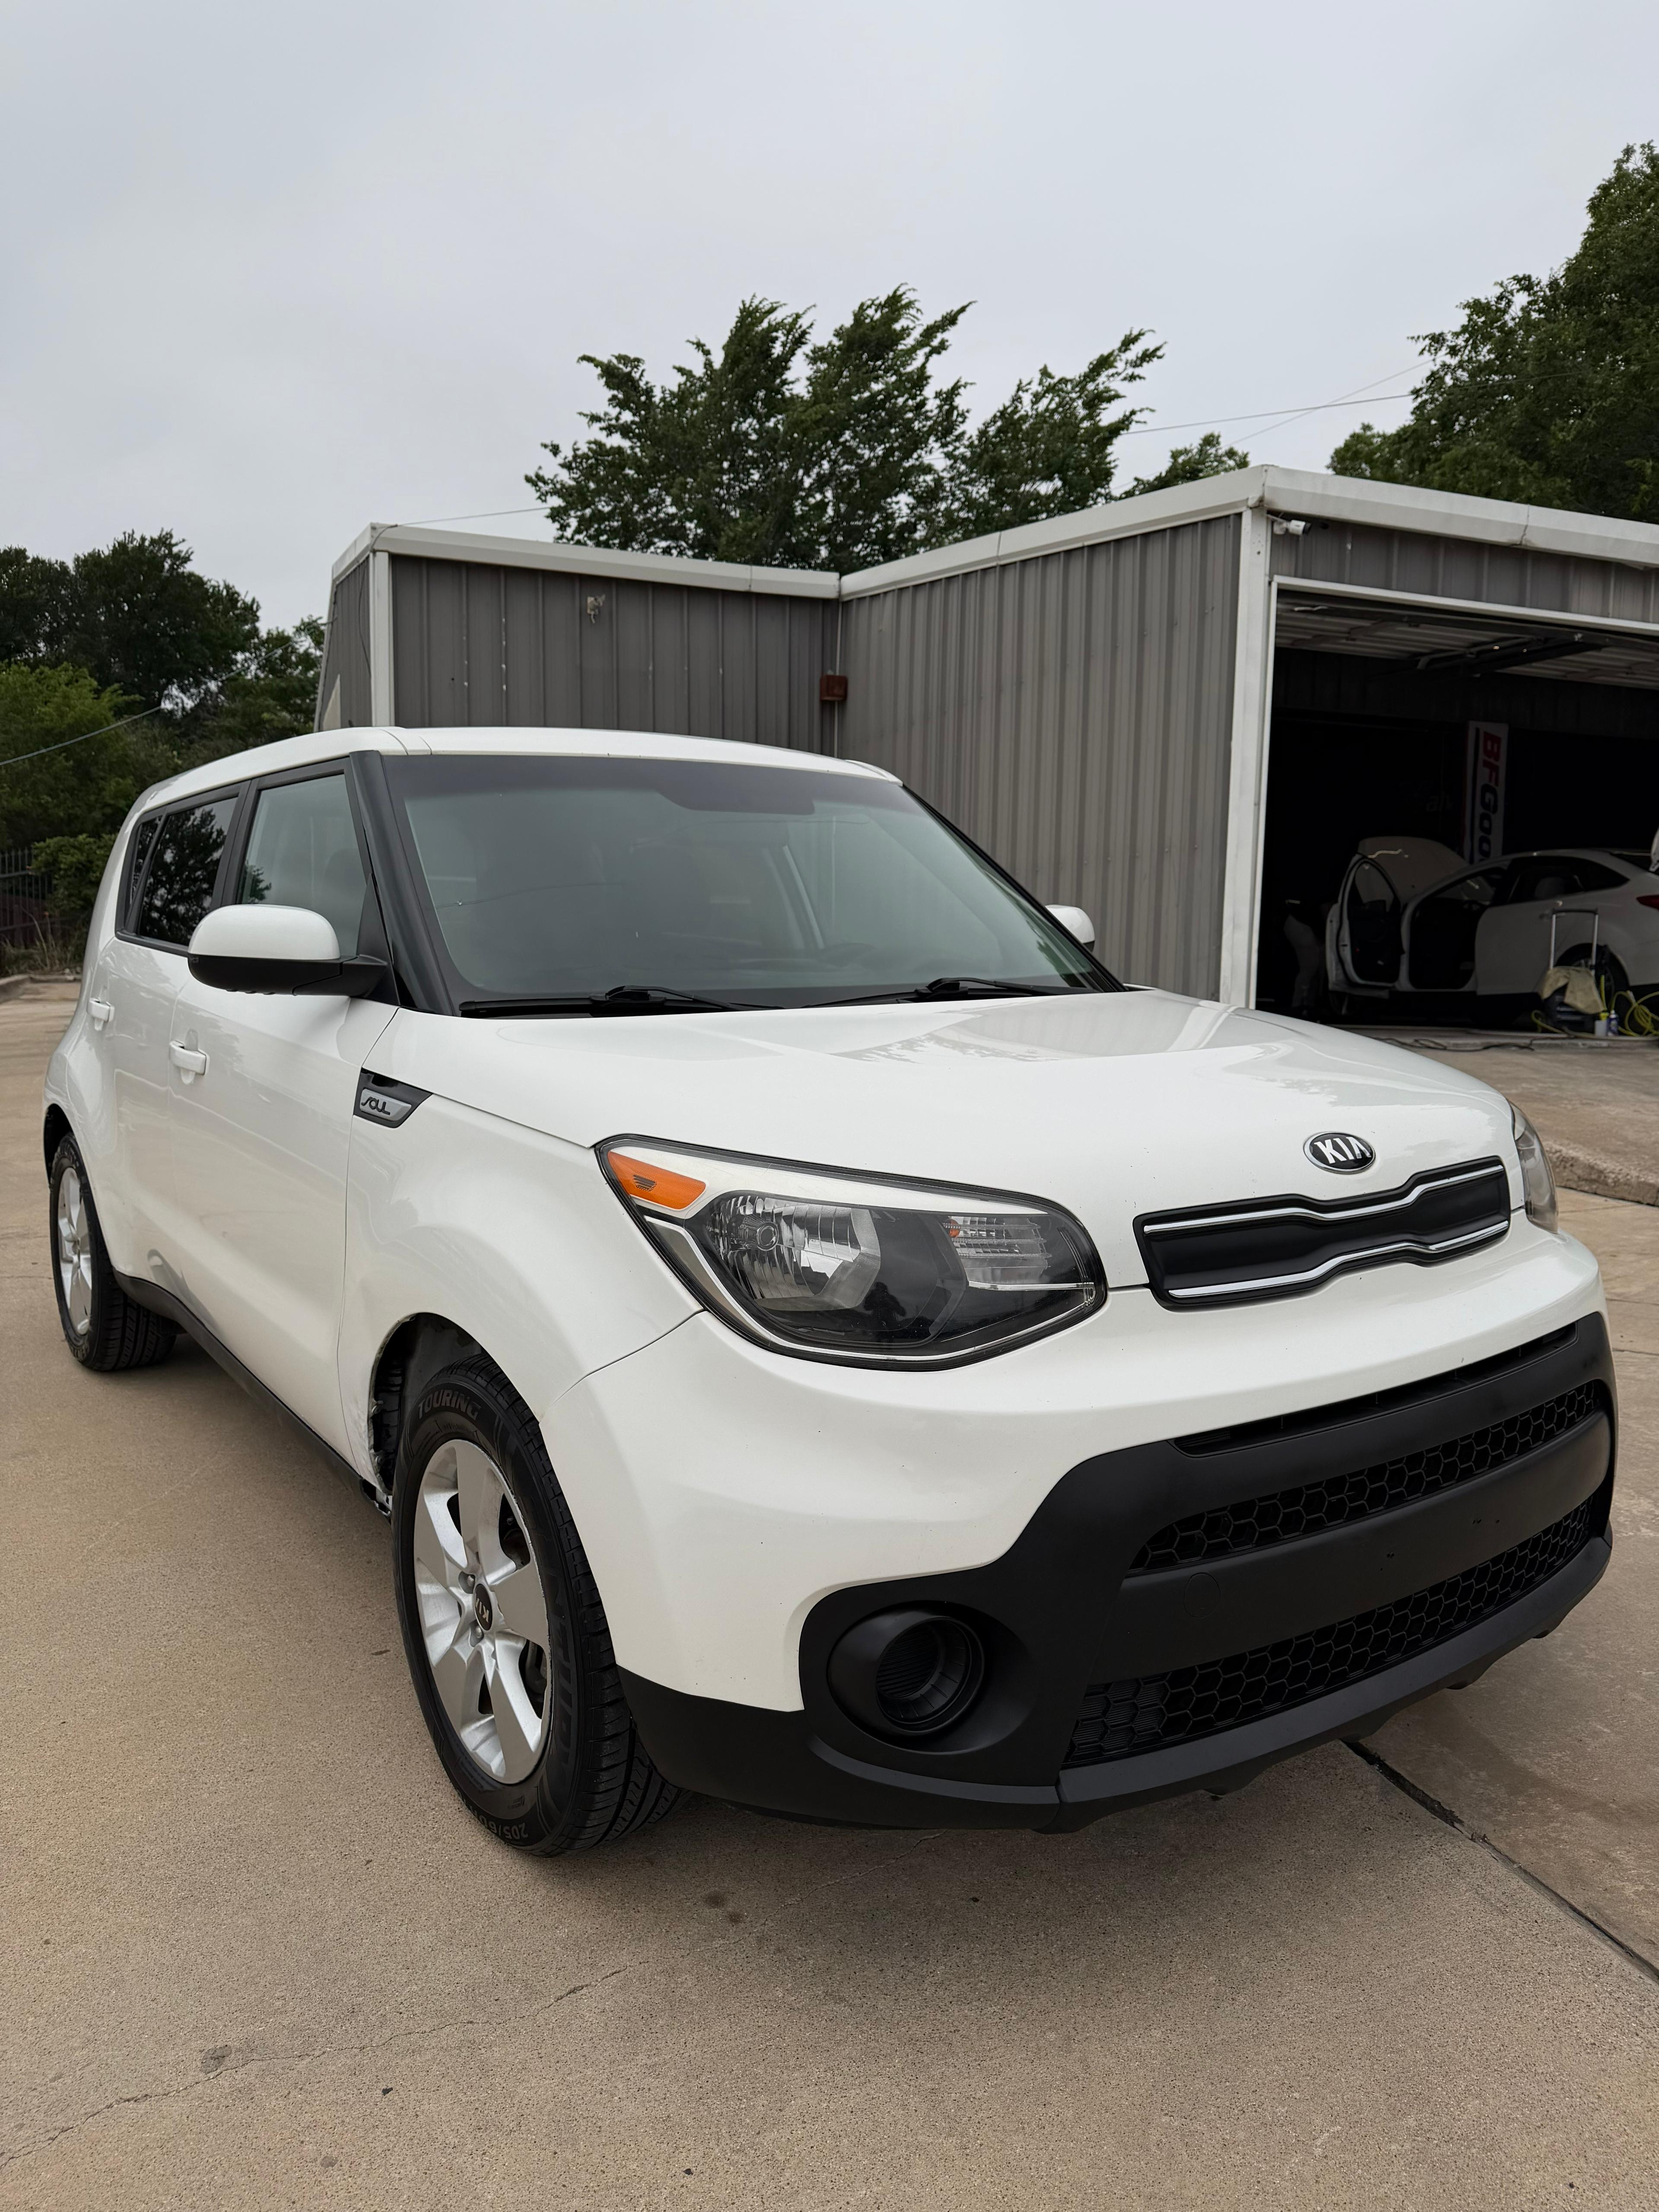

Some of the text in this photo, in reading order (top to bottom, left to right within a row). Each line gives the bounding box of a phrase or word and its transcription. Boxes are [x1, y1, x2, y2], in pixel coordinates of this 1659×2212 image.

[1479, 731, 1502, 861] BFGoo
[1314, 1136, 1372, 1164] KIA
[418, 1389, 482, 1421] TOURING
[474, 1592, 489, 1624] KIA
